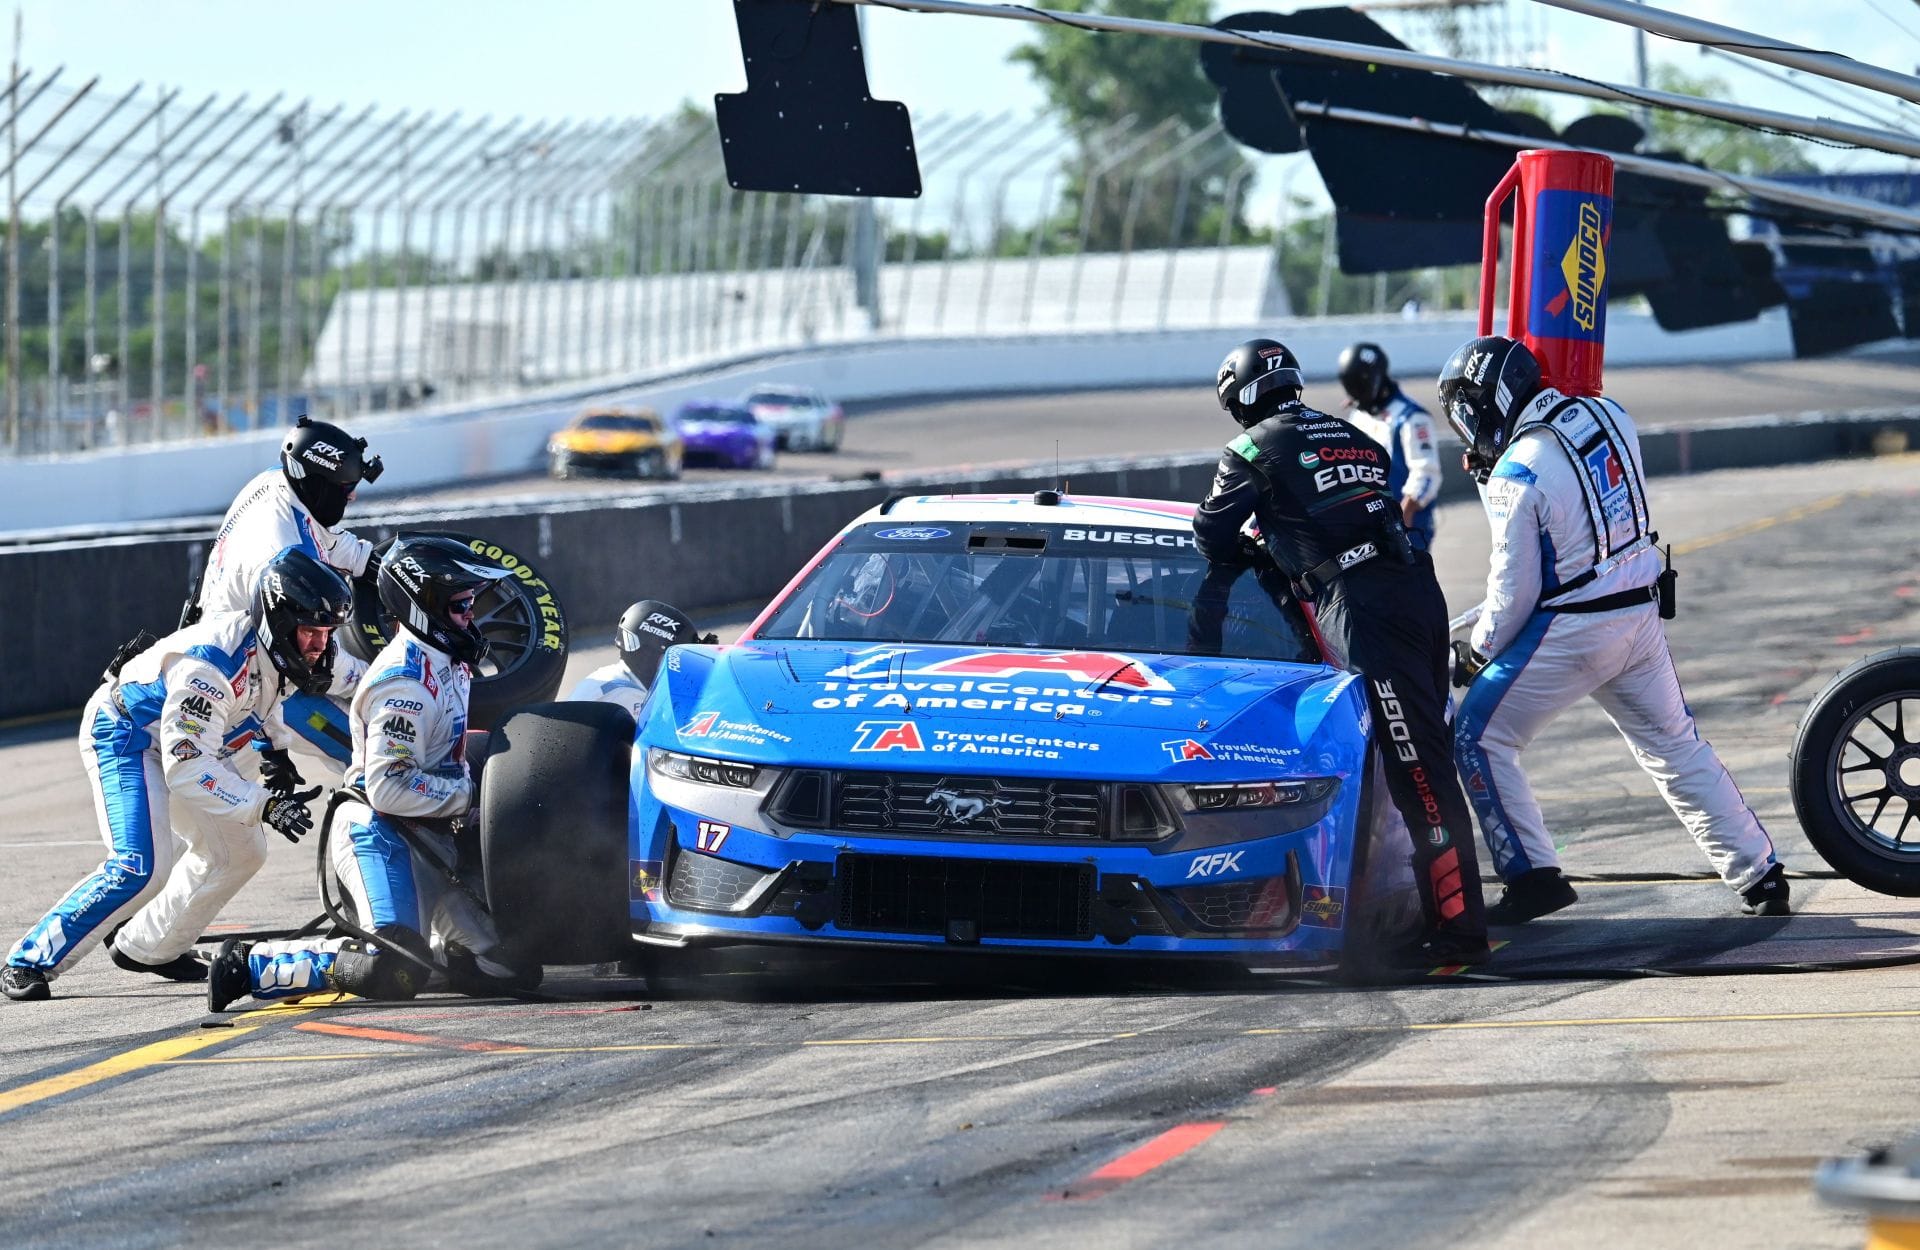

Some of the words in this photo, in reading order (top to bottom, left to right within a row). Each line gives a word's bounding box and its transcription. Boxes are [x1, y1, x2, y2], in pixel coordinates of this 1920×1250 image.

[1575, 206, 1599, 327] SUNOCO
[1267, 355, 1283, 370] 17
[1464, 349, 1483, 381] RFK
[1535, 391, 1559, 413] RFK
[302, 449, 339, 472] FASTENAL
[311, 441, 345, 461] RFK
[1319, 446, 1379, 464] Castrol
[1314, 464, 1387, 493] EDGE
[1366, 499, 1385, 513] BEST
[886, 528, 938, 540] Ford
[1063, 529, 1197, 548] BUESCH
[391, 563, 422, 595] FASTENAL
[401, 556, 431, 584] RFK
[639, 621, 676, 641] FASTENAL
[647, 612, 680, 631] RFK
[190, 677, 225, 700] FORD
[817, 681, 1174, 706] TravelCenters
[180, 694, 212, 717] MAC
[384, 698, 424, 711] FORD
[812, 693, 867, 709] of
[180, 706, 211, 722] TOOLS
[1374, 679, 1419, 762] EDGE
[382, 730, 416, 743] TOOLS
[383, 715, 417, 737] MAC
[709, 729, 722, 739] of
[721, 730, 765, 745] America
[718, 720, 792, 742] TravelCenters
[850, 720, 926, 752] TA
[932, 742, 949, 753] of
[964, 742, 1060, 760] America
[934, 730, 1100, 752] TravelCenters
[1161, 738, 1215, 763] TA
[1210, 742, 1300, 756] TravelCenters
[1218, 751, 1230, 761] of
[1234, 753, 1285, 766] America
[199, 771, 218, 793] TA
[409, 776, 427, 796] TA
[697, 820, 732, 853] 17
[1186, 850, 1246, 879] RFK
